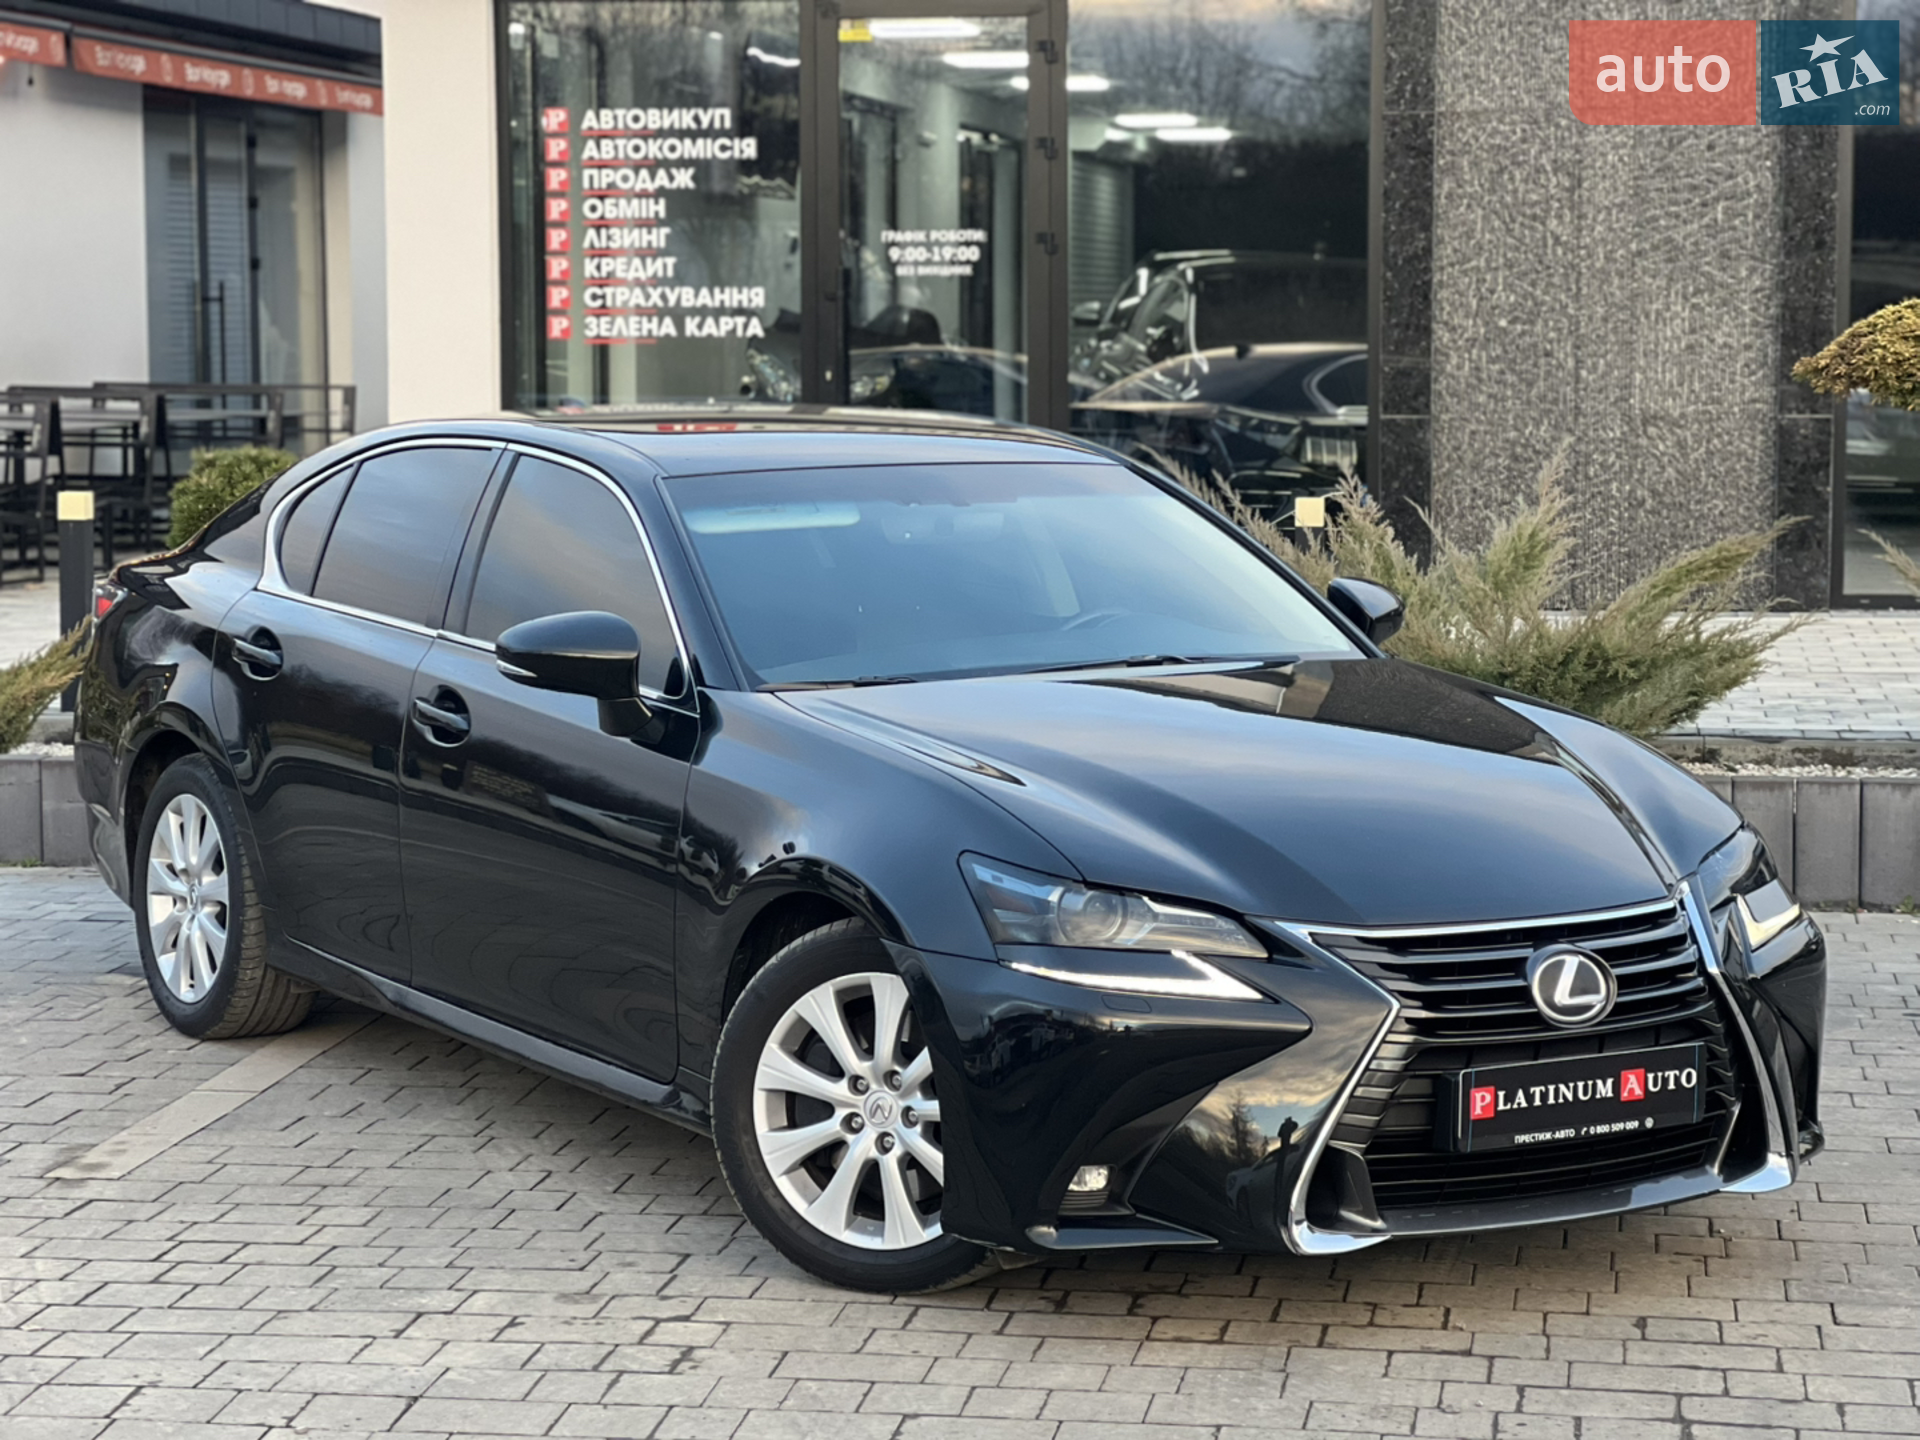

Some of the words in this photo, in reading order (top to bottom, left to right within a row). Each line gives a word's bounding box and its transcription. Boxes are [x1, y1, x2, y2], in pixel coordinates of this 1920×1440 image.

[581, 107, 732, 130] АВТОВИКУП
[581, 136, 758, 160] АВТОКОМІСІЯ
[582, 167, 696, 191] ПРОДАЖ
[582, 197, 666, 219] ОБМІН
[583, 227, 672, 249] ЛІЗИНГ
[888, 245, 981, 262] 9:00-19:00
[583, 256, 677, 280] КРЕДИТ
[583, 286, 765, 308] СТРАХУВАННЯ
[583, 316, 678, 338] ЗЕЛЕНА
[684, 316, 765, 338] КАРТА
[1473, 1077, 1615, 1116] PLATINUM
[1622, 1067, 1698, 1098] AUTO
[1514, 1128, 1576, 1144] ПРЕСТИЖ-АВТО
[1596, 1123, 1610, 1134] 800
[1611, 1121, 1625, 1132] 509
[1625, 1120, 1640, 1130] 009
